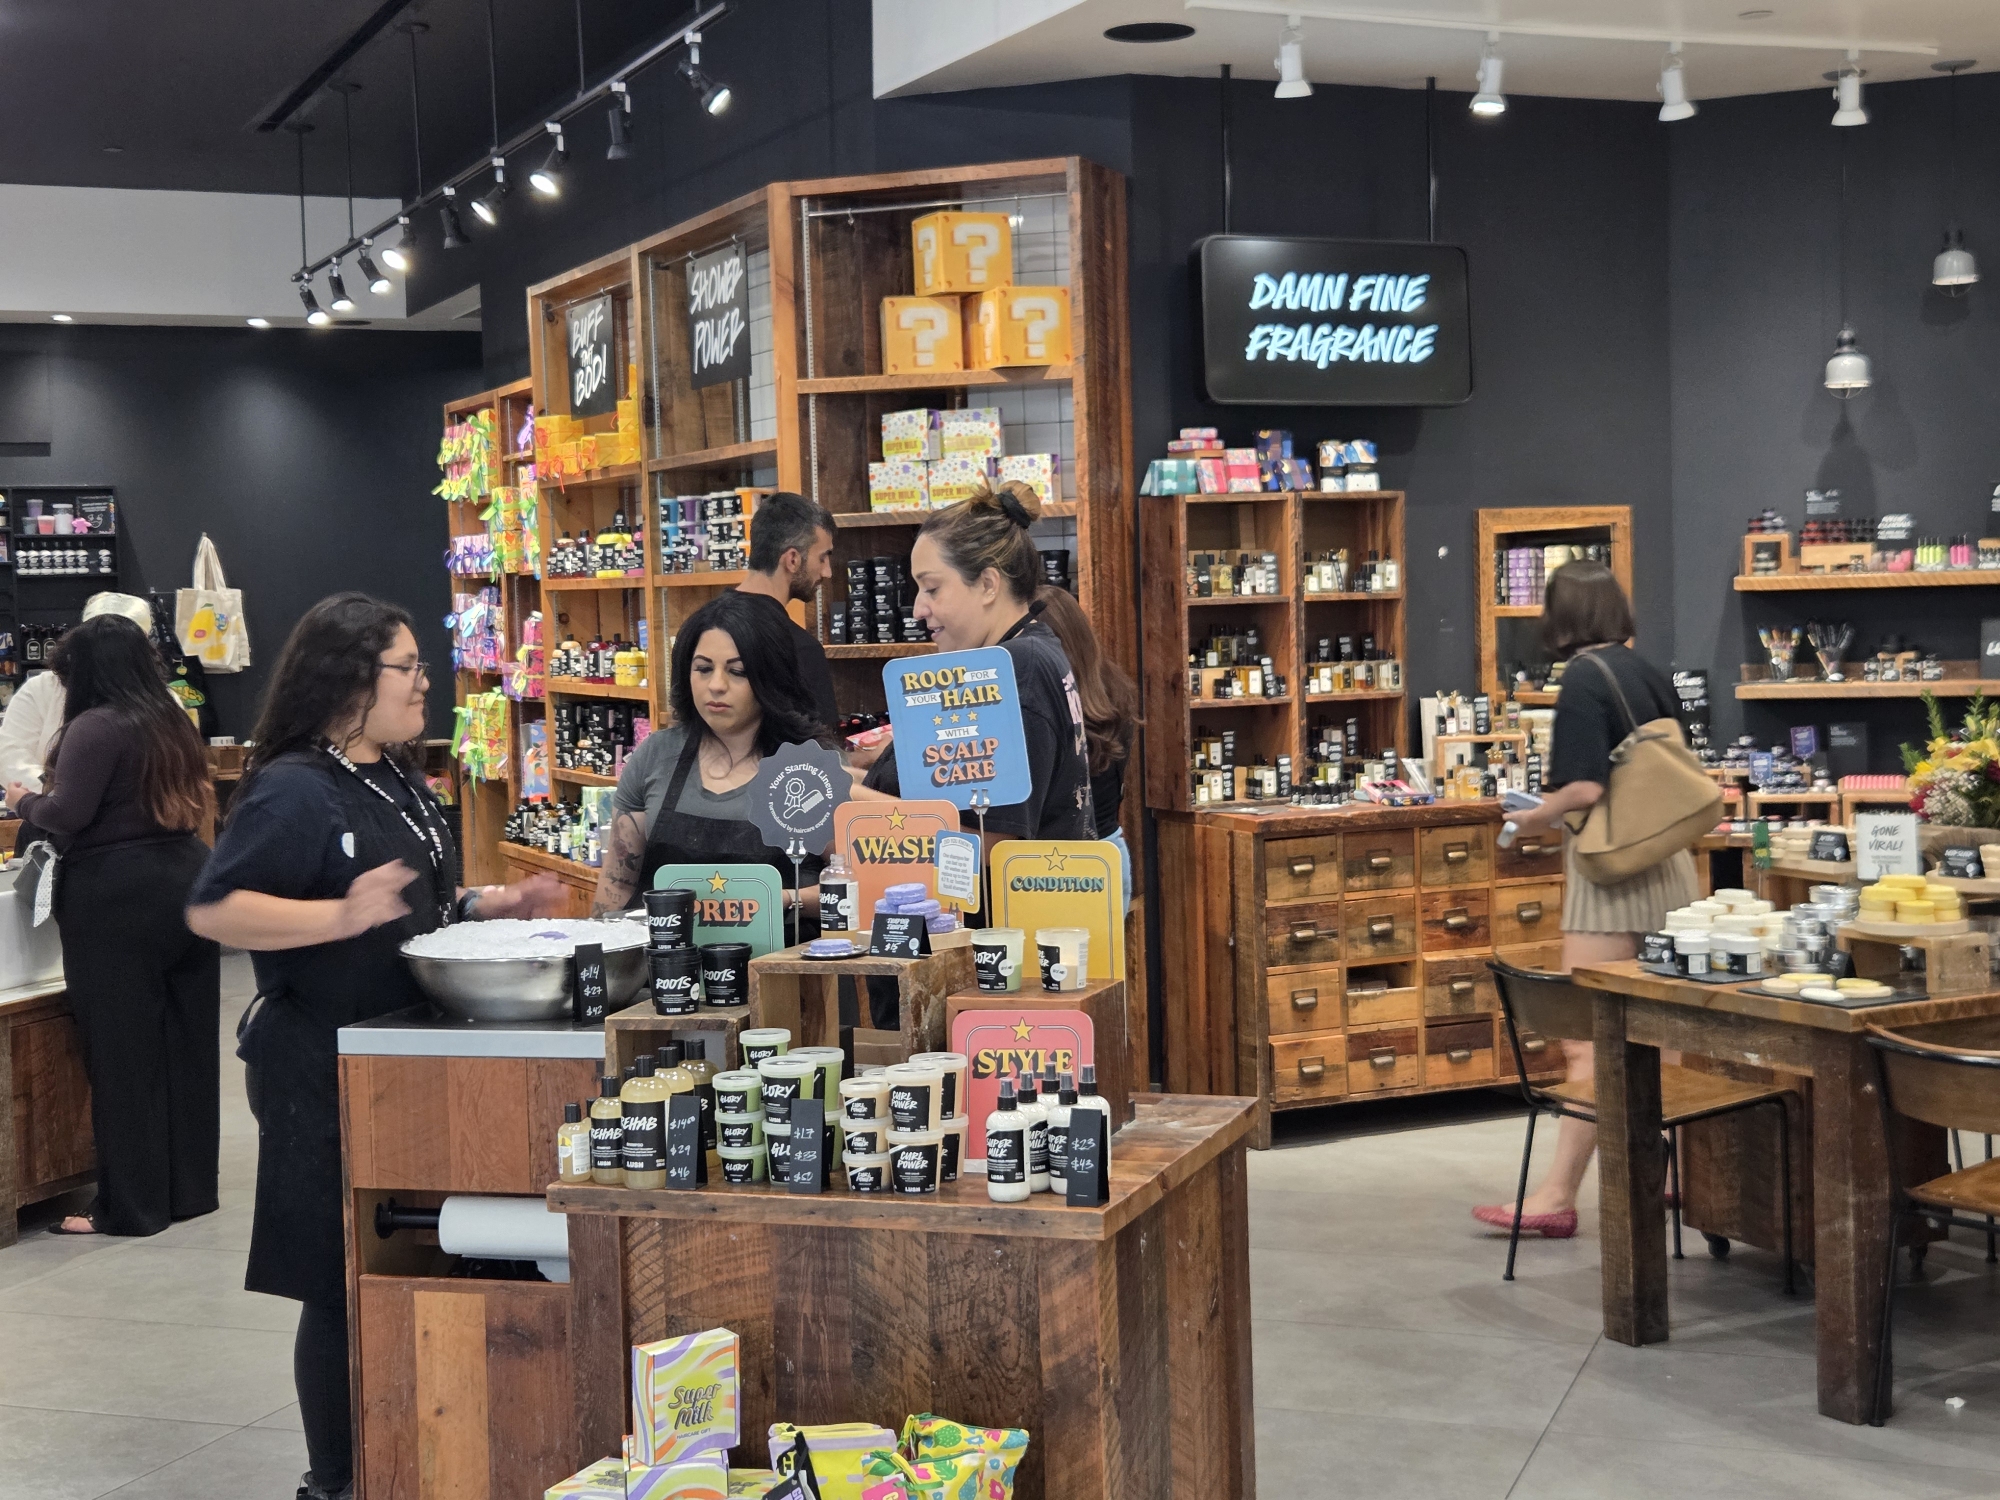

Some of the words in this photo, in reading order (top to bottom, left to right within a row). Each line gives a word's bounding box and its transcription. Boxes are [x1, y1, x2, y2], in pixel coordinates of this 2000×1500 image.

[690, 257, 743, 315] SHOWER
[1249, 271, 1348, 312] DAMN
[1349, 273, 1431, 313] FINE
[572, 303, 604, 359] BUFF
[690, 307, 745, 374] POWER
[1245, 323, 1439, 370] FRAGRANCE
[574, 342, 608, 408] BOD!
[875, 491, 898, 502] SUPER
[899, 490, 916, 500] MILK
[932, 487, 955, 497] SUPER
[902, 666, 967, 693] ROOT
[970, 670, 990, 680] FOR
[911, 694, 937, 704] YOUR
[942, 684, 1003, 710] HAIR
[944, 728, 970, 738] WITH
[327, 744, 358, 773] LUSH
[923, 737, 999, 767] SCALP
[932, 760, 997, 787] CARE
[769, 771, 786, 790] Your
[784, 763, 819, 776] Starting
[817, 770, 834, 800] Lineup
[401, 811, 426, 842] LUSH
[786, 824, 793, 833] by
[793, 826, 816, 834] haircare
[1871, 825, 1900, 838] GONE
[1868, 839, 1904, 852] VIRAL!
[1010, 875, 1105, 893] CONDITION
[649, 913, 681, 928] ROOTS
[973, 950, 1002, 965] LORY
[580, 964, 600, 981] $14
[704, 968, 736, 982] ROOTS
[656, 976, 692, 990] ROOTS
[583, 985, 603, 997] $27
[586, 1004, 603, 1016] $42
[749, 1050, 774, 1060] GLORY
[972, 1048, 1073, 1080] STYLE
[719, 1094, 743, 1104] GLORY
[892, 1090, 913, 1100] CURL
[890, 1099, 918, 1110] POWER
[620, 1116, 658, 1131] REHAB
[591, 1127, 623, 1140] REHAB
[724, 1127, 749, 1138] GLORY
[670, 1144, 691, 1156] $29
[1071, 1138, 1096, 1151] $23
[900, 1151, 924, 1160] CURL
[988, 1148, 1008, 1158] MILK
[626, 1160, 644, 1168] LUSH
[725, 1162, 749, 1172] GLORY
[896, 1159, 929, 1169] POWER
[1070, 1157, 1094, 1171] $43
[669, 1166, 691, 1177] $46
[667, 1383, 722, 1412] Super
[676, 1430, 700, 1440] HAIRCARE
[700, 1427, 712, 1435] GIFT
